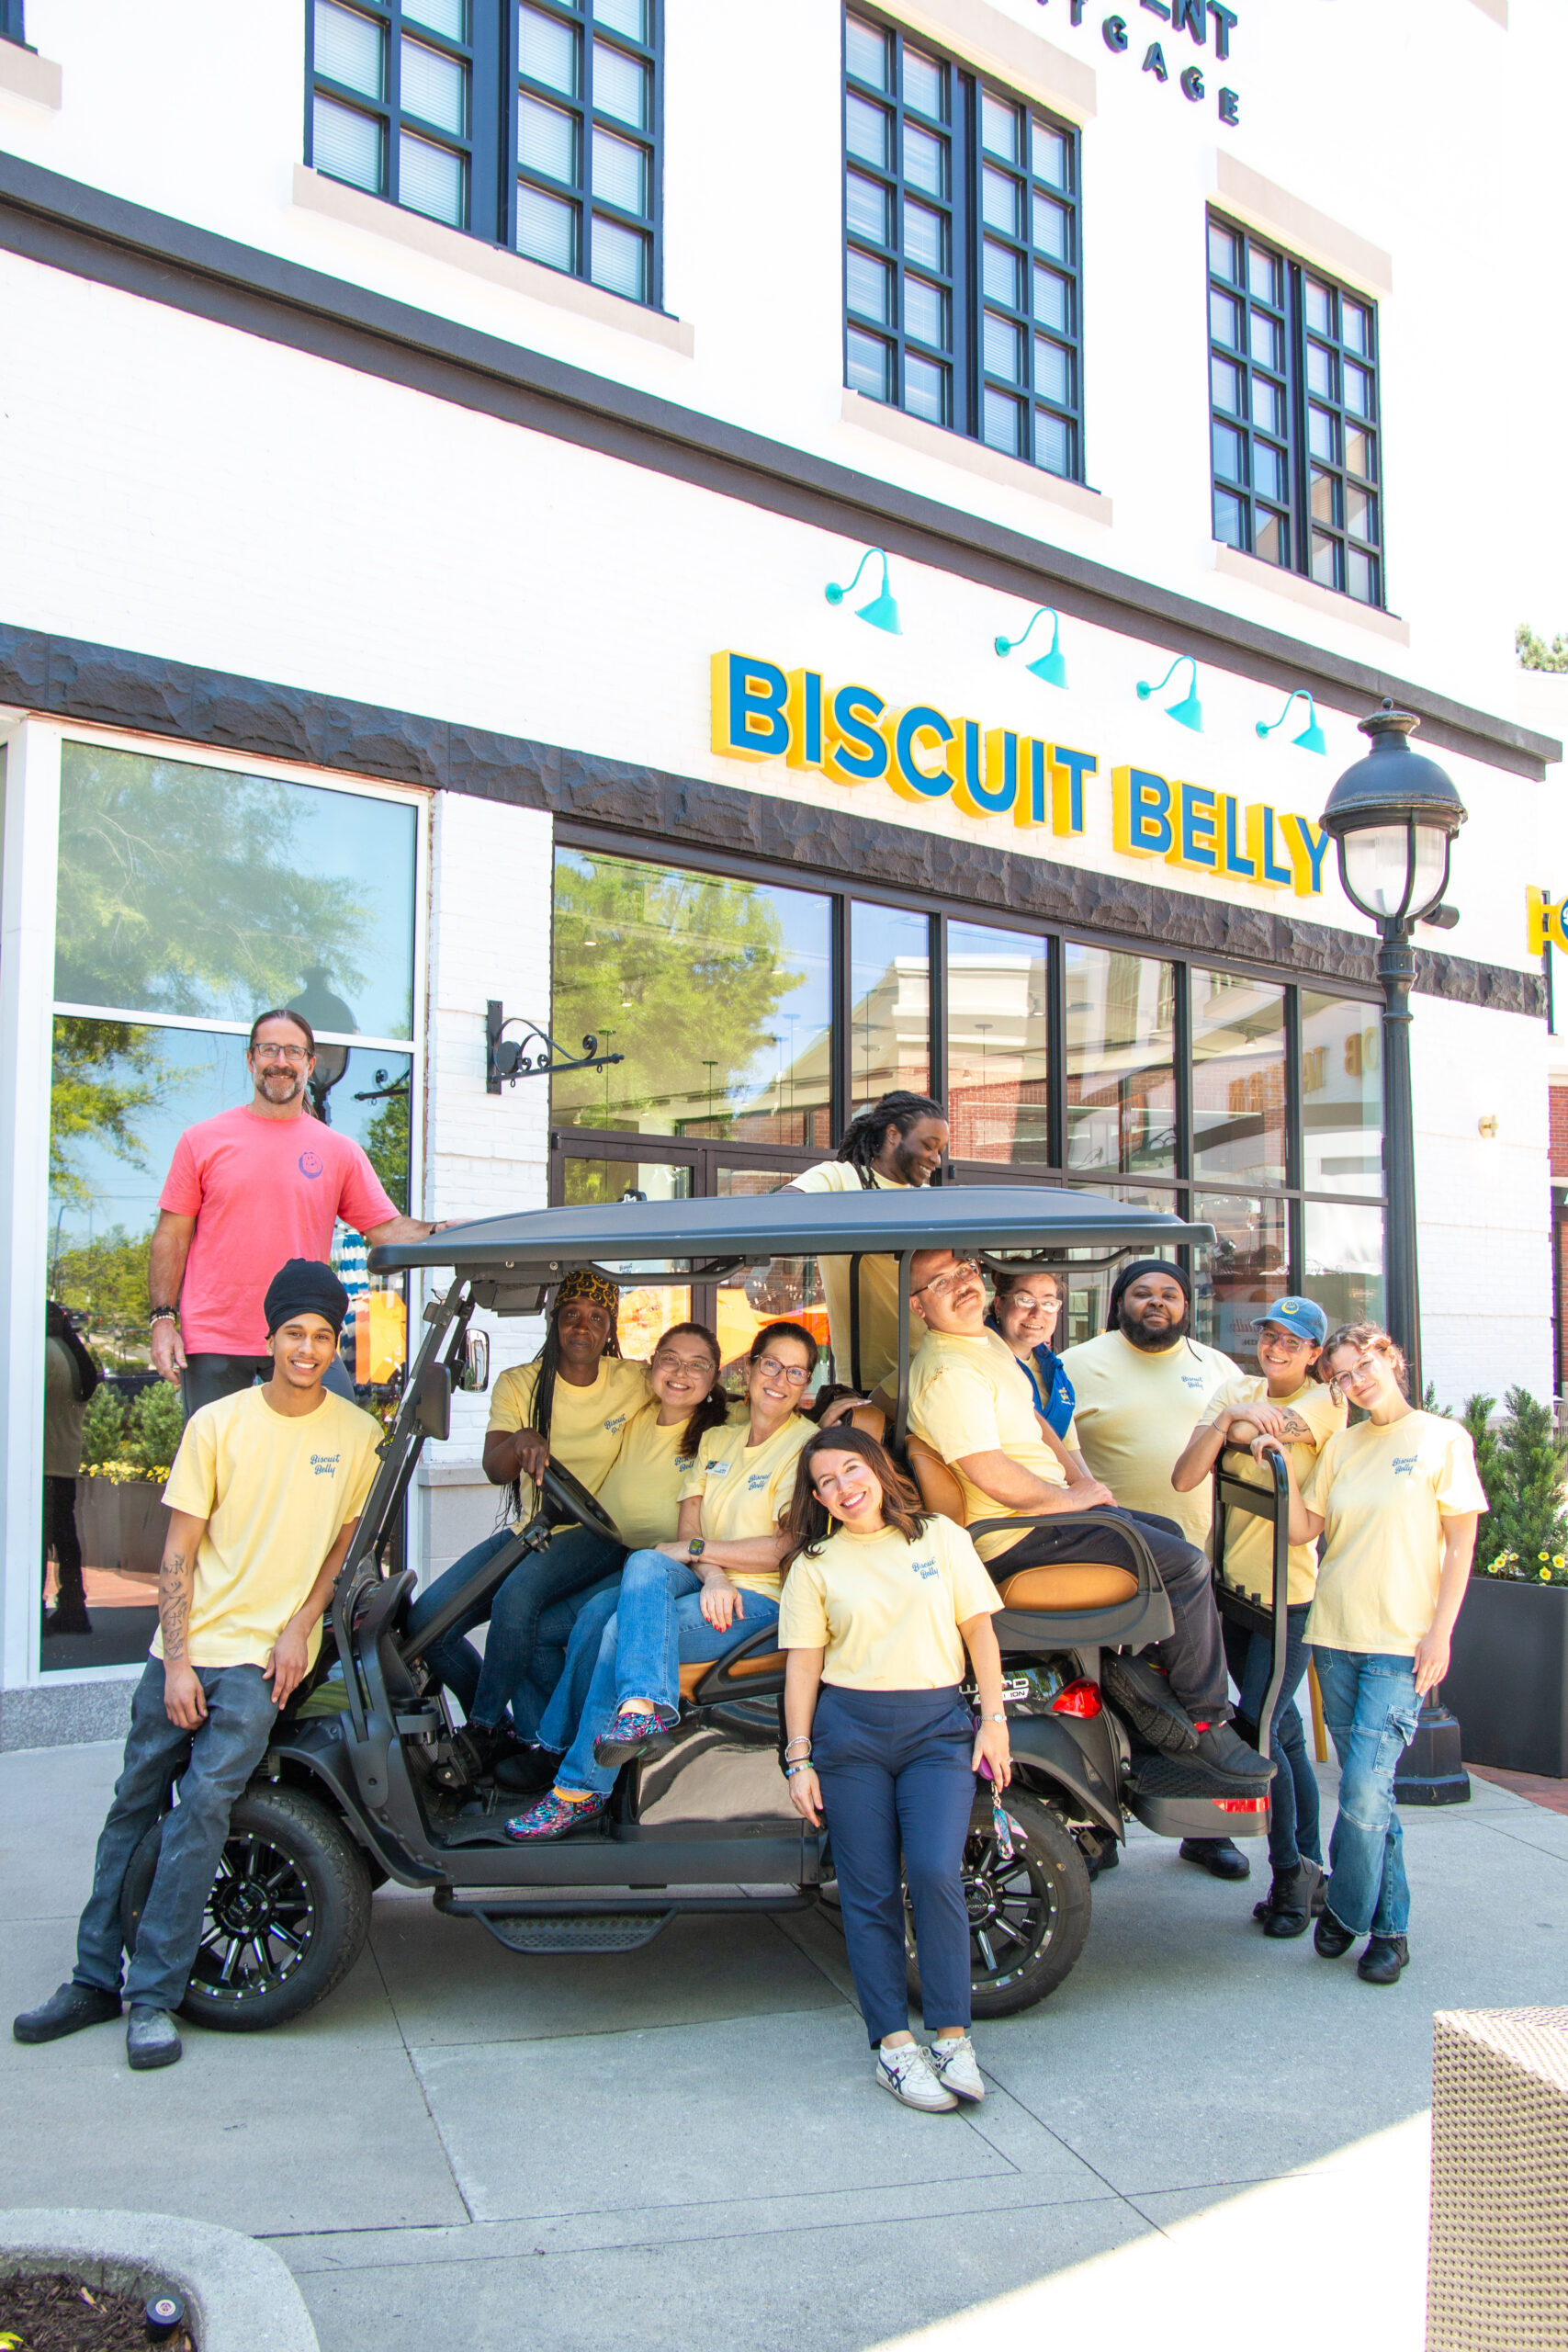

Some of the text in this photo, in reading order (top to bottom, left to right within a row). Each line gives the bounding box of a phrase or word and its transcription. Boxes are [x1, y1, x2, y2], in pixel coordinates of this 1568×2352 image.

[710, 649, 1332, 899] BISCUIT BELLY
[604, 1413, 626, 1430] Biscuit
[310, 1453, 341, 1465] Biscuit
[1392, 1454, 1418, 1467] Biscuit
[314, 1463, 336, 1478] Belly
[1394, 1463, 1414, 1476] Belly
[919, 1566, 940, 1579] Belly
